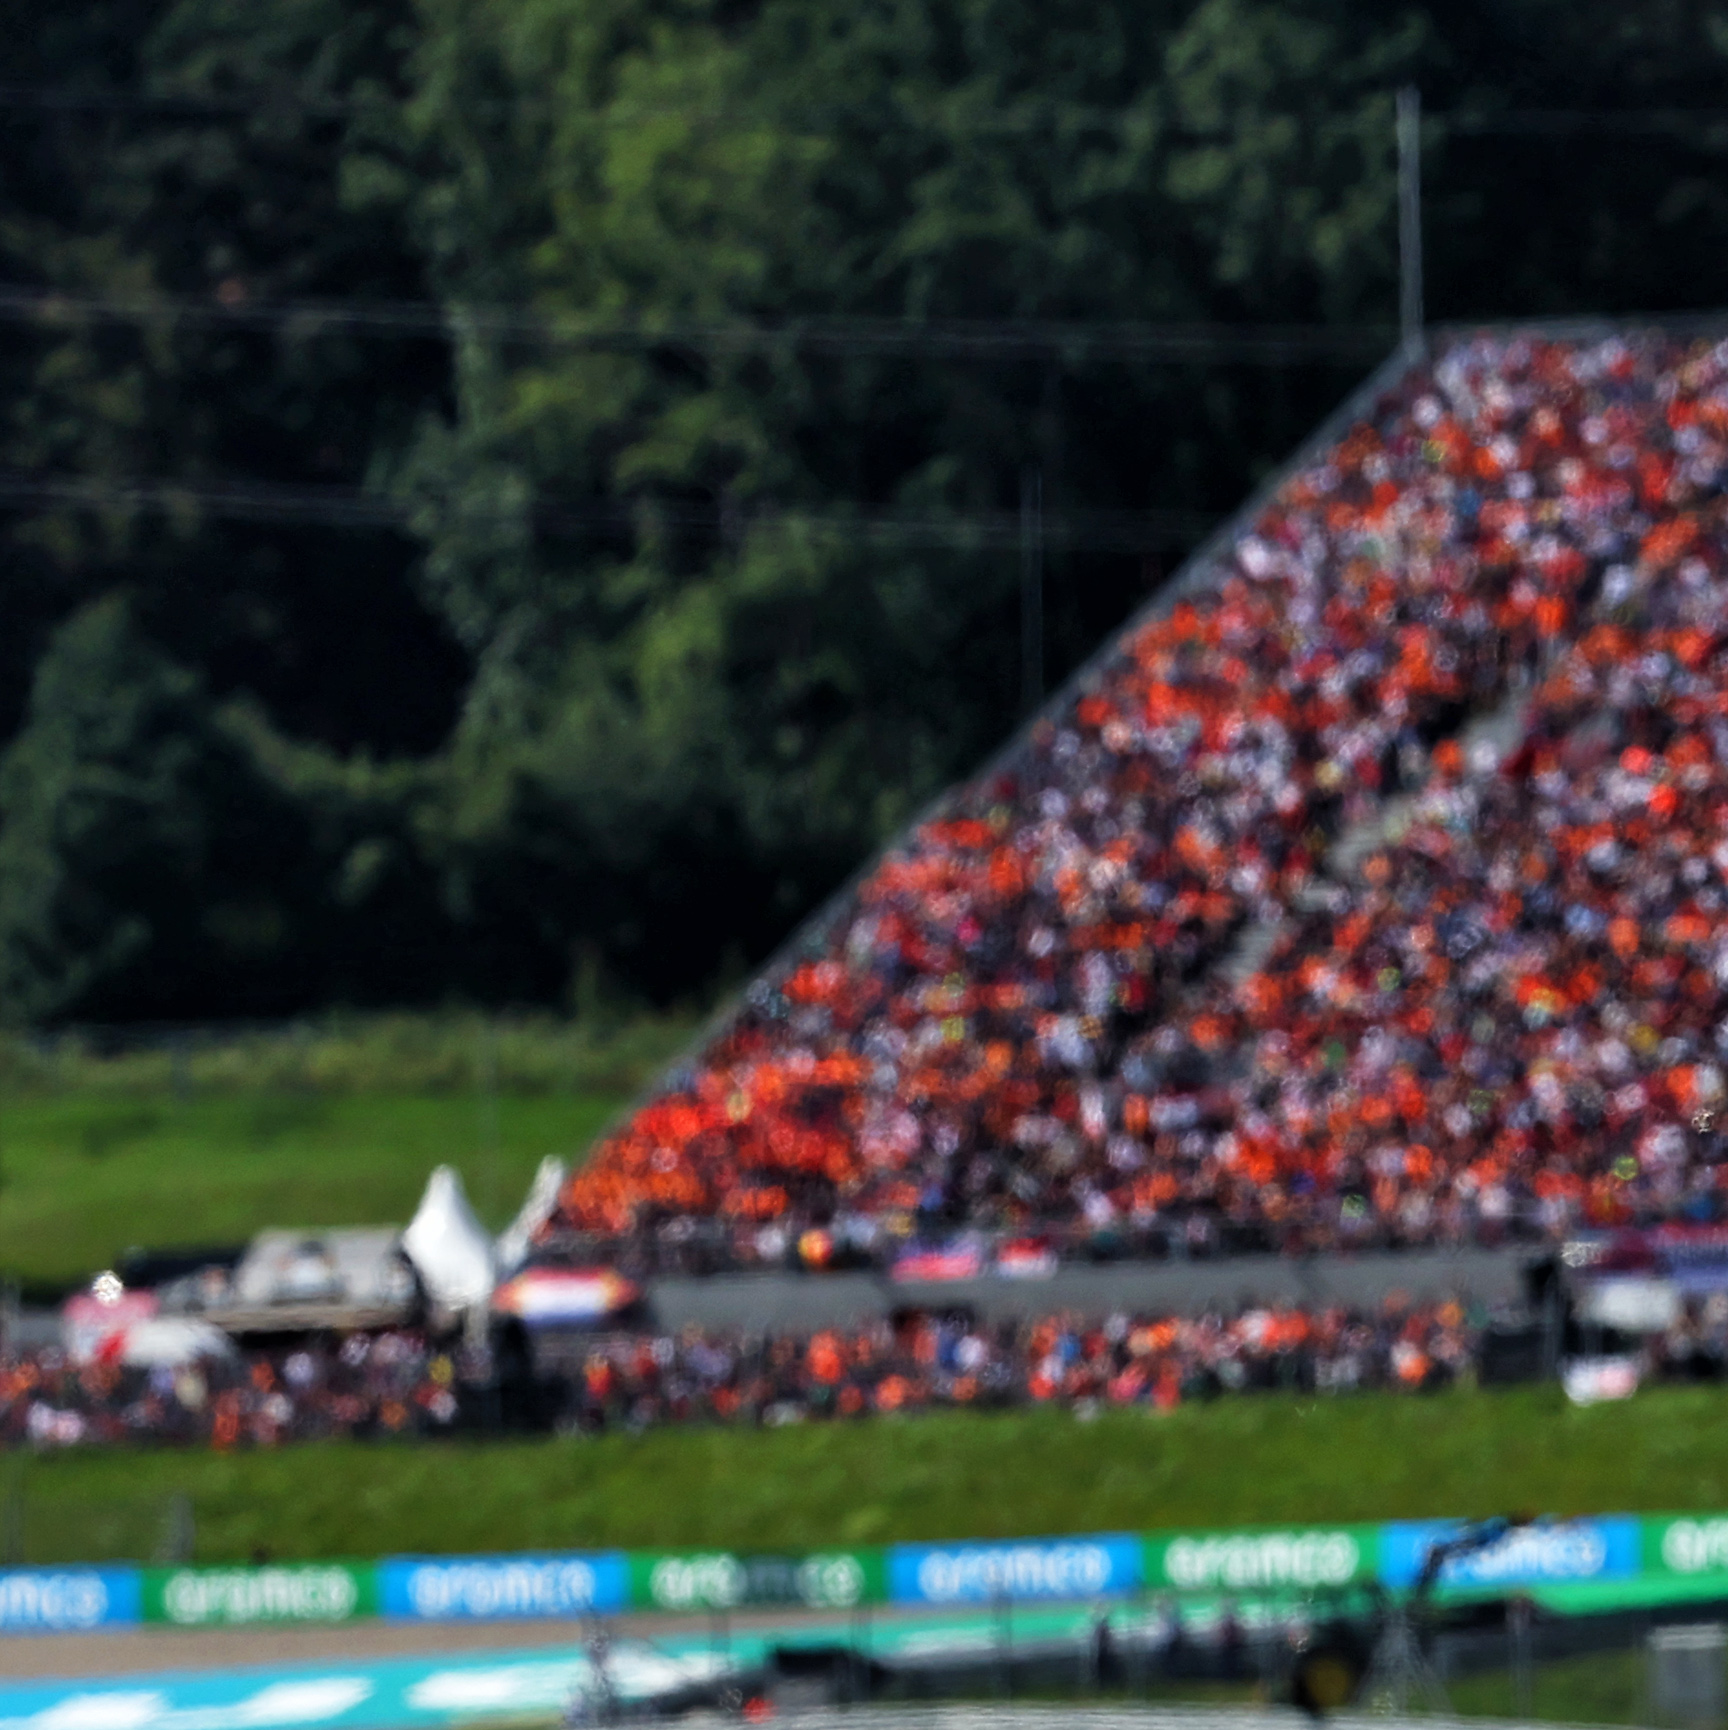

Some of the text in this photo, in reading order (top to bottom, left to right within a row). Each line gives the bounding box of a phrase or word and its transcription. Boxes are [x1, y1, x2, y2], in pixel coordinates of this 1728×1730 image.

[918, 1545, 1112, 1600] aramco
[1163, 1532, 1360, 1588] aramco
[163, 1566, 358, 1625] aramco
[407, 1560, 595, 1618] aramco
